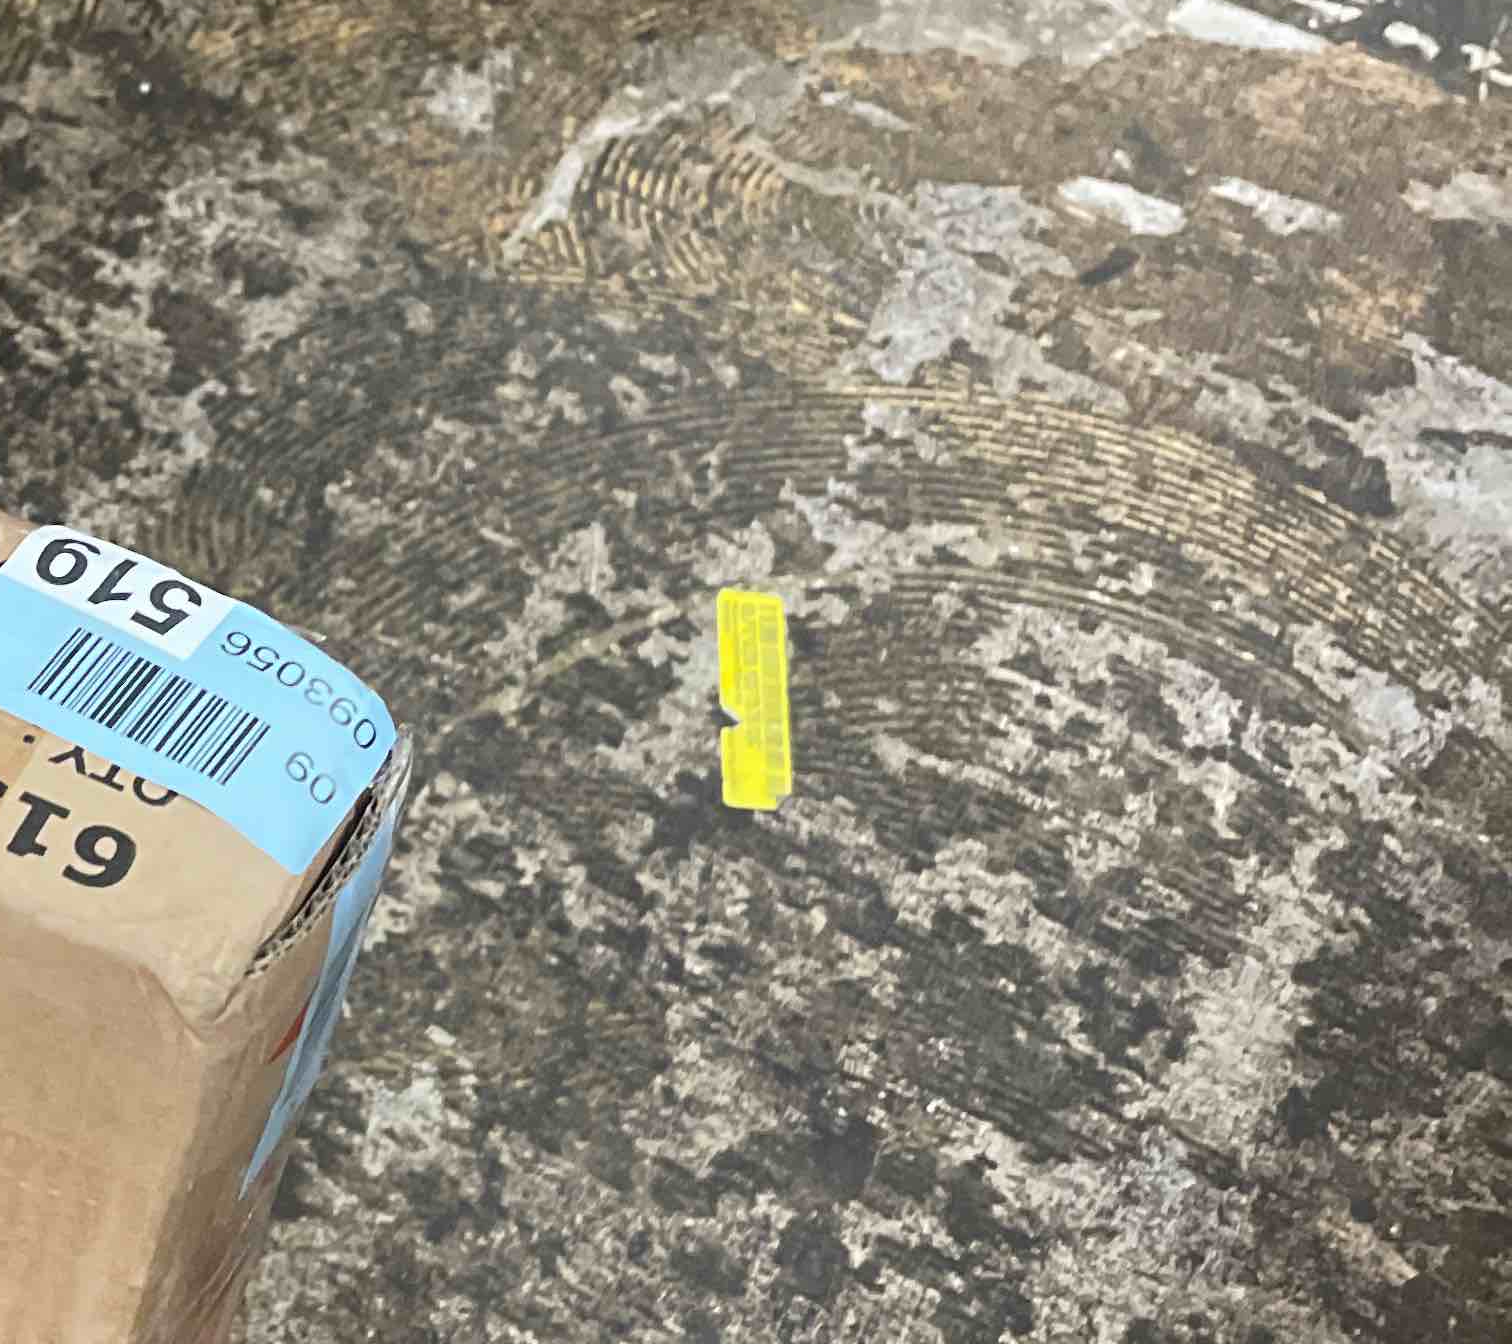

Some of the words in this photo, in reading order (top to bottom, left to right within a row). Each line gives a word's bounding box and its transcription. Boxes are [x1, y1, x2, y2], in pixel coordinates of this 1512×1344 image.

[35, 538, 202, 636] 519
[219, 630, 378, 750] 093056
[285, 751, 338, 806] 09
